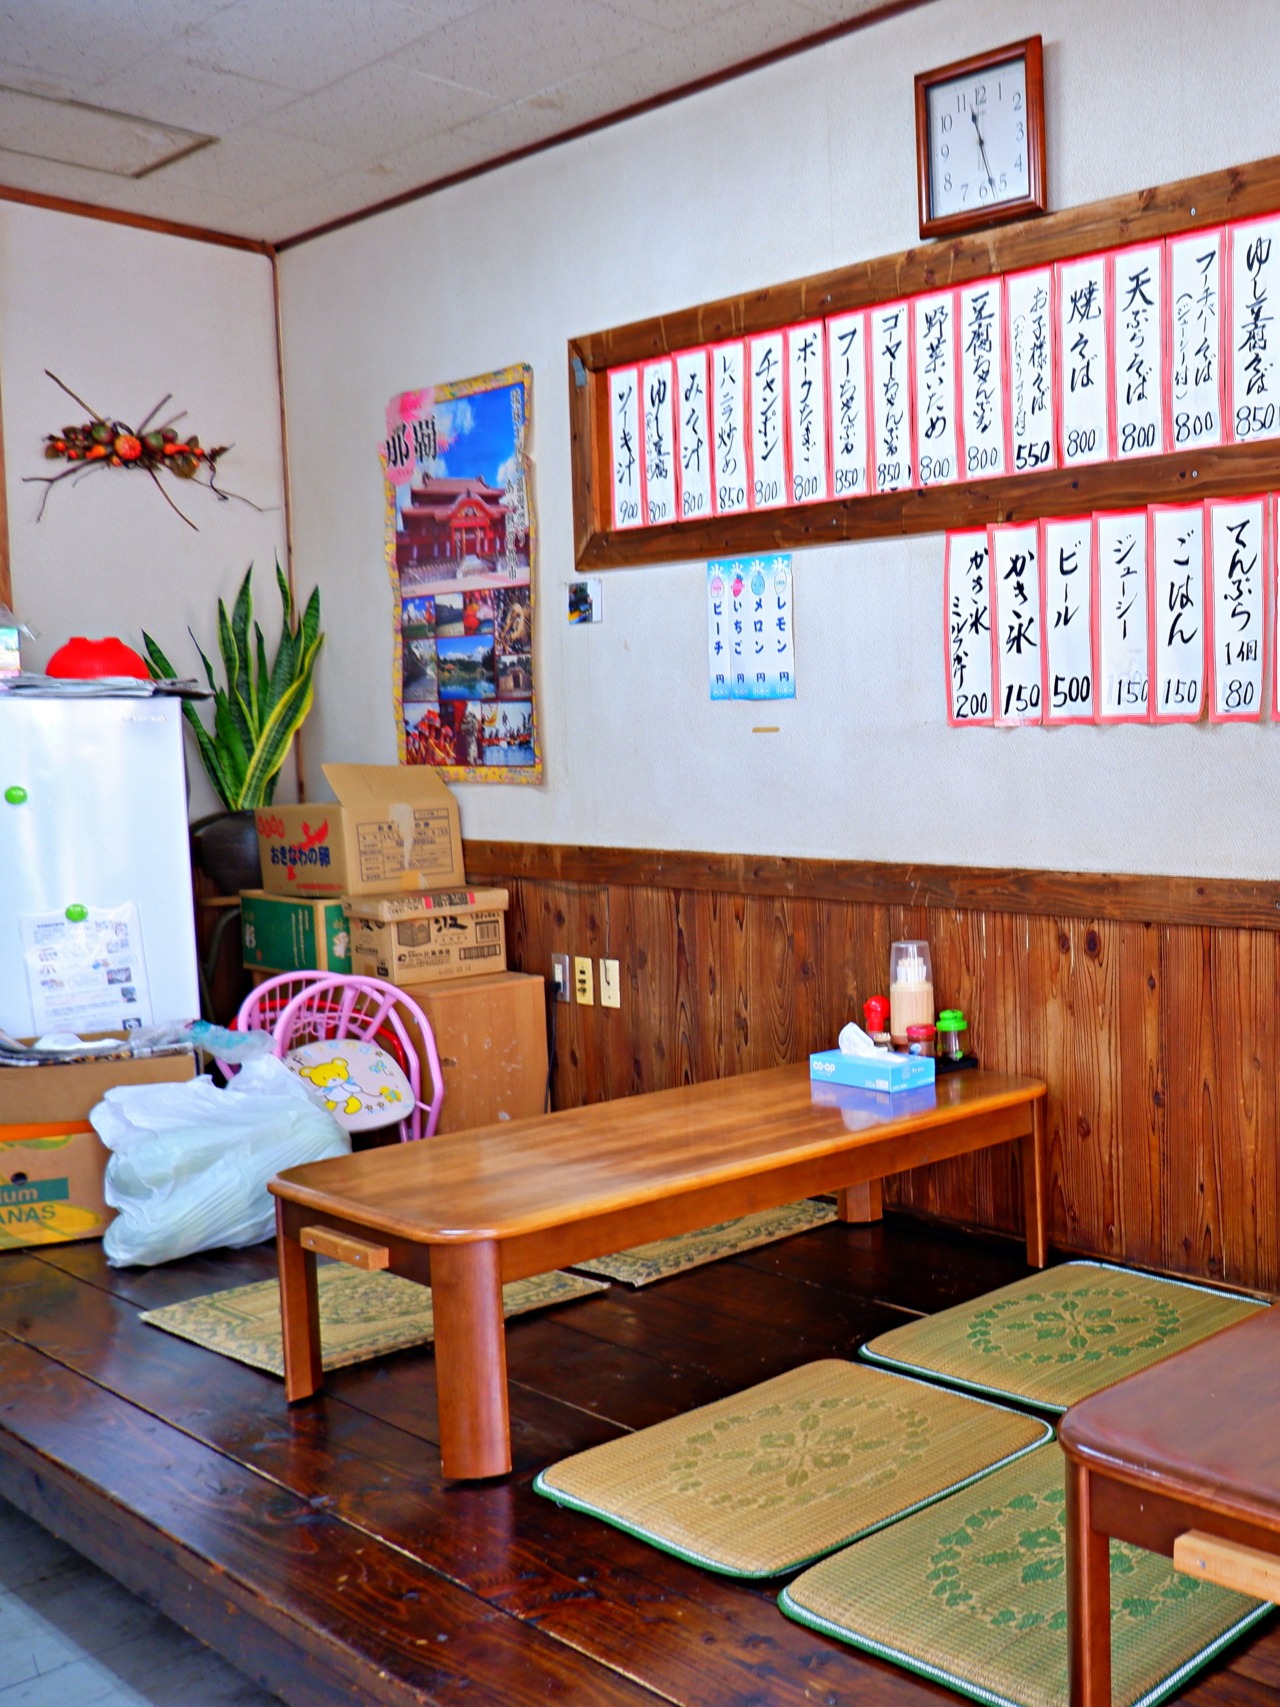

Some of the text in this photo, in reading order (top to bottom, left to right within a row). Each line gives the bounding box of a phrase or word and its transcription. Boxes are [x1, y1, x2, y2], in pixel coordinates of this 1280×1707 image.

[957, 94, 966, 113] 11
[975, 85, 986, 105] 12
[1013, 92, 1021, 111] 2
[941, 114, 952, 134] 10
[1016, 122, 1024, 141] 3
[941, 145, 949, 163] 9
[1014, 155, 1022, 171] 4
[944, 174, 952, 192] 8
[961, 184, 969, 202] 7
[979, 182, 988, 200] 6
[1000, 174, 1007, 192] 5
[1068, 280, 1101, 393] 焼そば
[923, 306, 948, 439] 野菜いため
[755, 348, 778, 461] チャンポン
[683, 373, 703, 472] みそ汁
[1175, 411, 1213, 442] 800
[1067, 429, 1095, 457] 800
[1122, 423, 1155, 452] 800
[968, 446, 997, 471] 800
[1016, 440, 1050, 470] 550
[920, 456, 950, 485] 800
[719, 486, 744, 510] 850
[755, 480, 777, 504] 800
[794, 475, 817, 501] 800
[684, 491, 703, 515] 800
[1054, 541, 1081, 628] ビール
[1113, 534, 1137, 640] ジューシー
[1168, 529, 1198, 647] ごはん
[1003, 549, 1037, 654] かき氷
[733, 600, 743, 655] いちご
[754, 598, 764, 654] メロン
[776, 596, 787, 653] レモン
[716, 674, 725, 685] 円
[737, 673, 745, 683] 円
[756, 672, 766, 683] 円
[779, 671, 790, 683] 円
[1004, 684, 1040, 715] 150
[1053, 675, 1090, 708] 500
[1118, 679, 1148, 706] 150
[1165, 679, 1197, 704] 150
[1226, 680, 1254, 708] 80
[956, 692, 987, 718] 200
[271, 845, 331, 868] おきなわの卵
